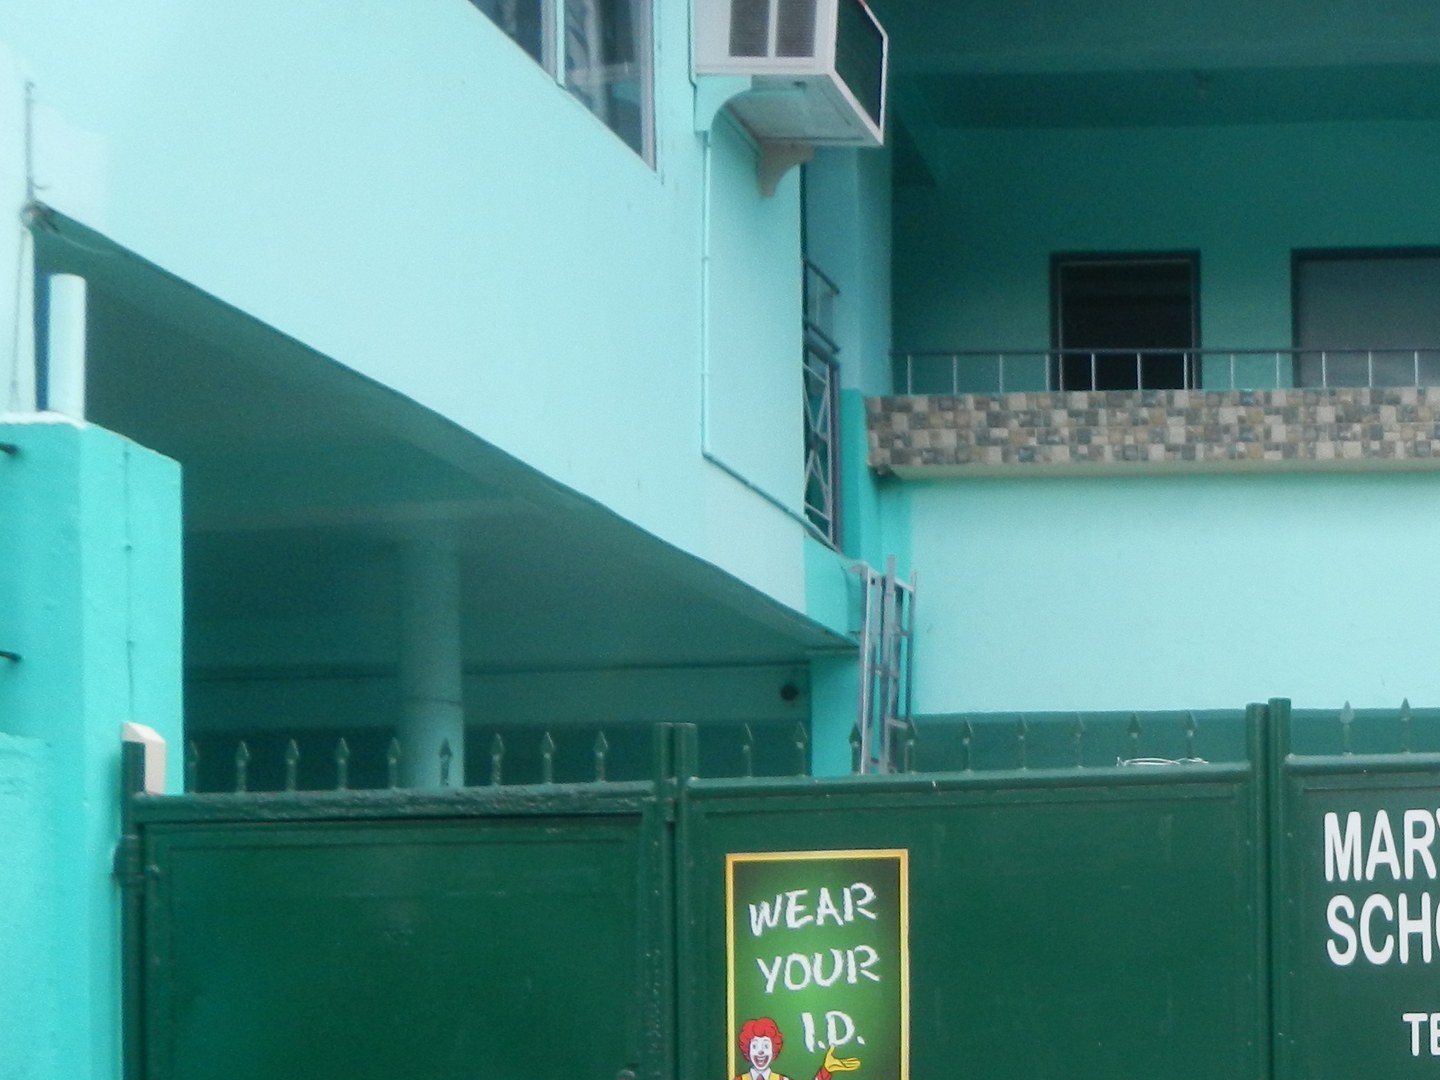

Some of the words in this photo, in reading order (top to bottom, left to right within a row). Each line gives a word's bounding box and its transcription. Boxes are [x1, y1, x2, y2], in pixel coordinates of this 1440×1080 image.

[749, 882, 878, 937] WEAR
[757, 944, 880, 993] YOUR
[801, 1010, 866, 1052] I.D.
